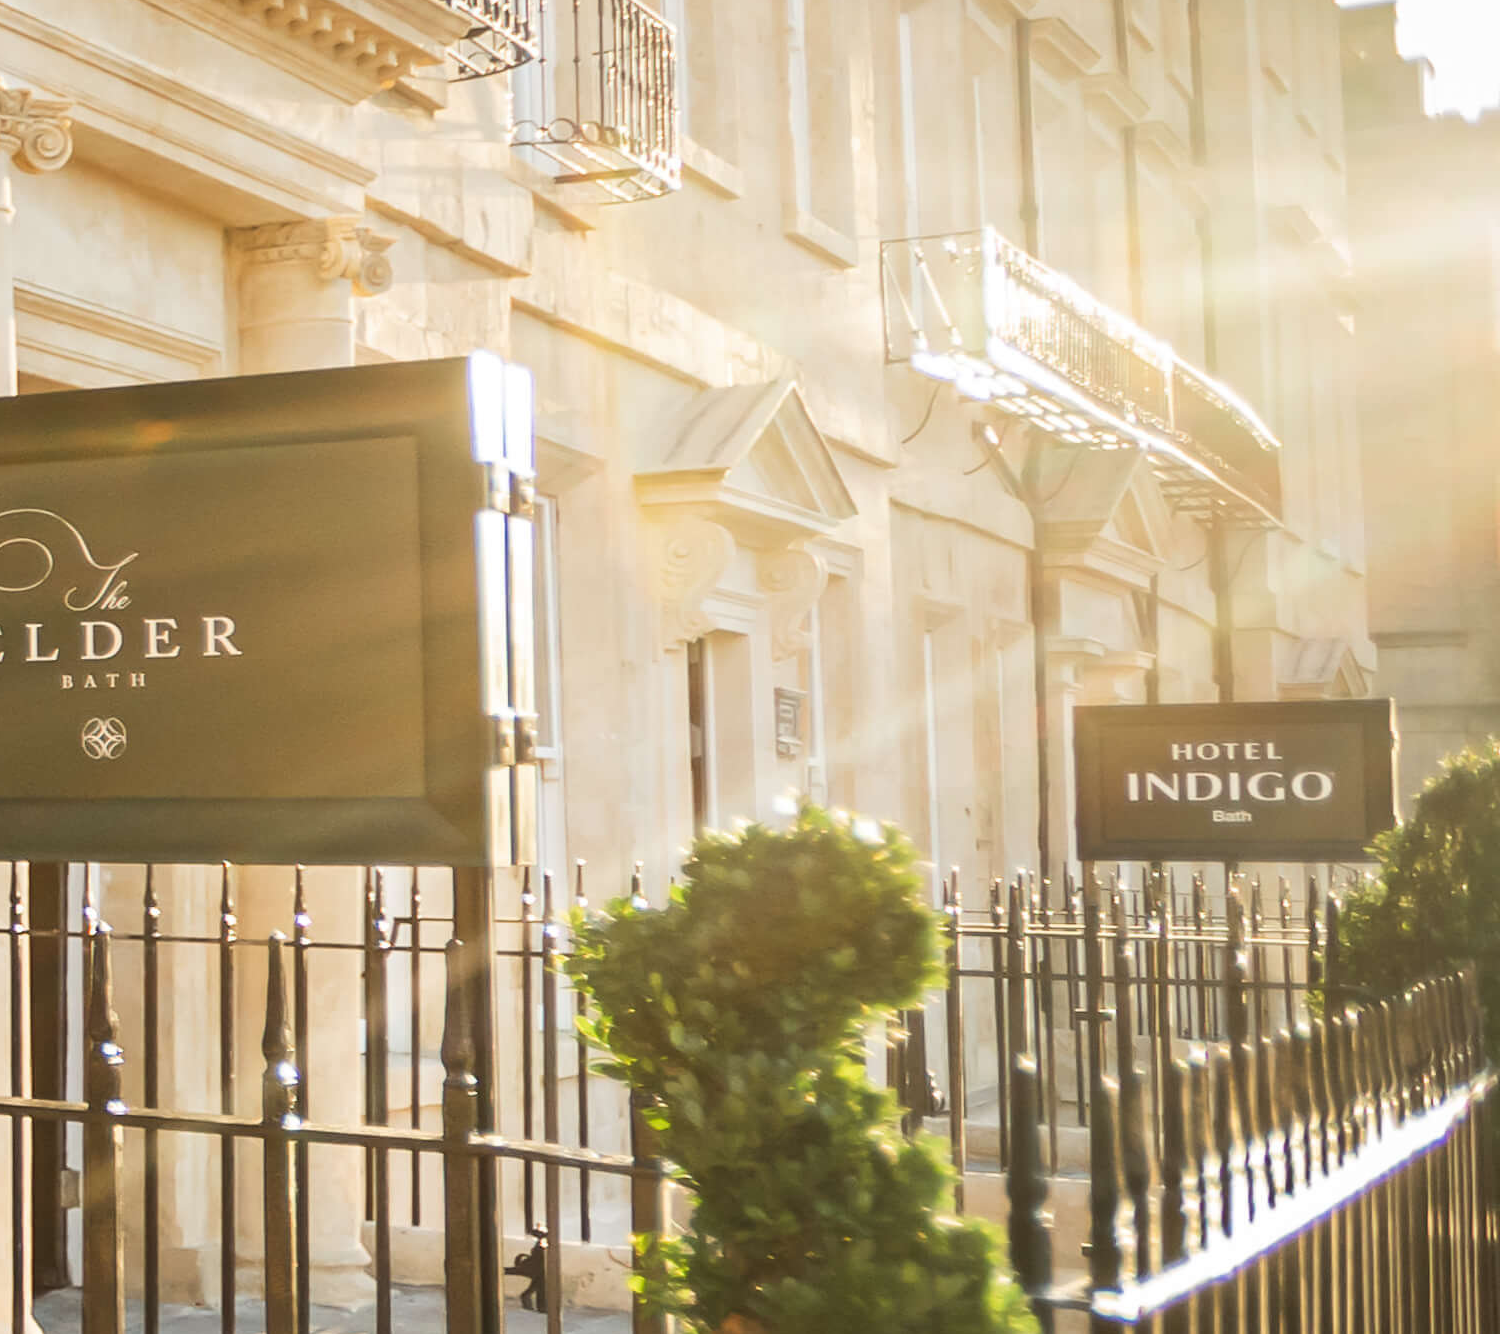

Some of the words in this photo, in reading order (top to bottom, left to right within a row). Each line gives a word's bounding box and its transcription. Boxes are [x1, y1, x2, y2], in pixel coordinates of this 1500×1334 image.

[60, 672, 147, 690] BATH
[1171, 742, 1283, 761] HOTEL
[1127, 771, 1334, 801] INDIGO
[1212, 810, 1252, 823] Bath
